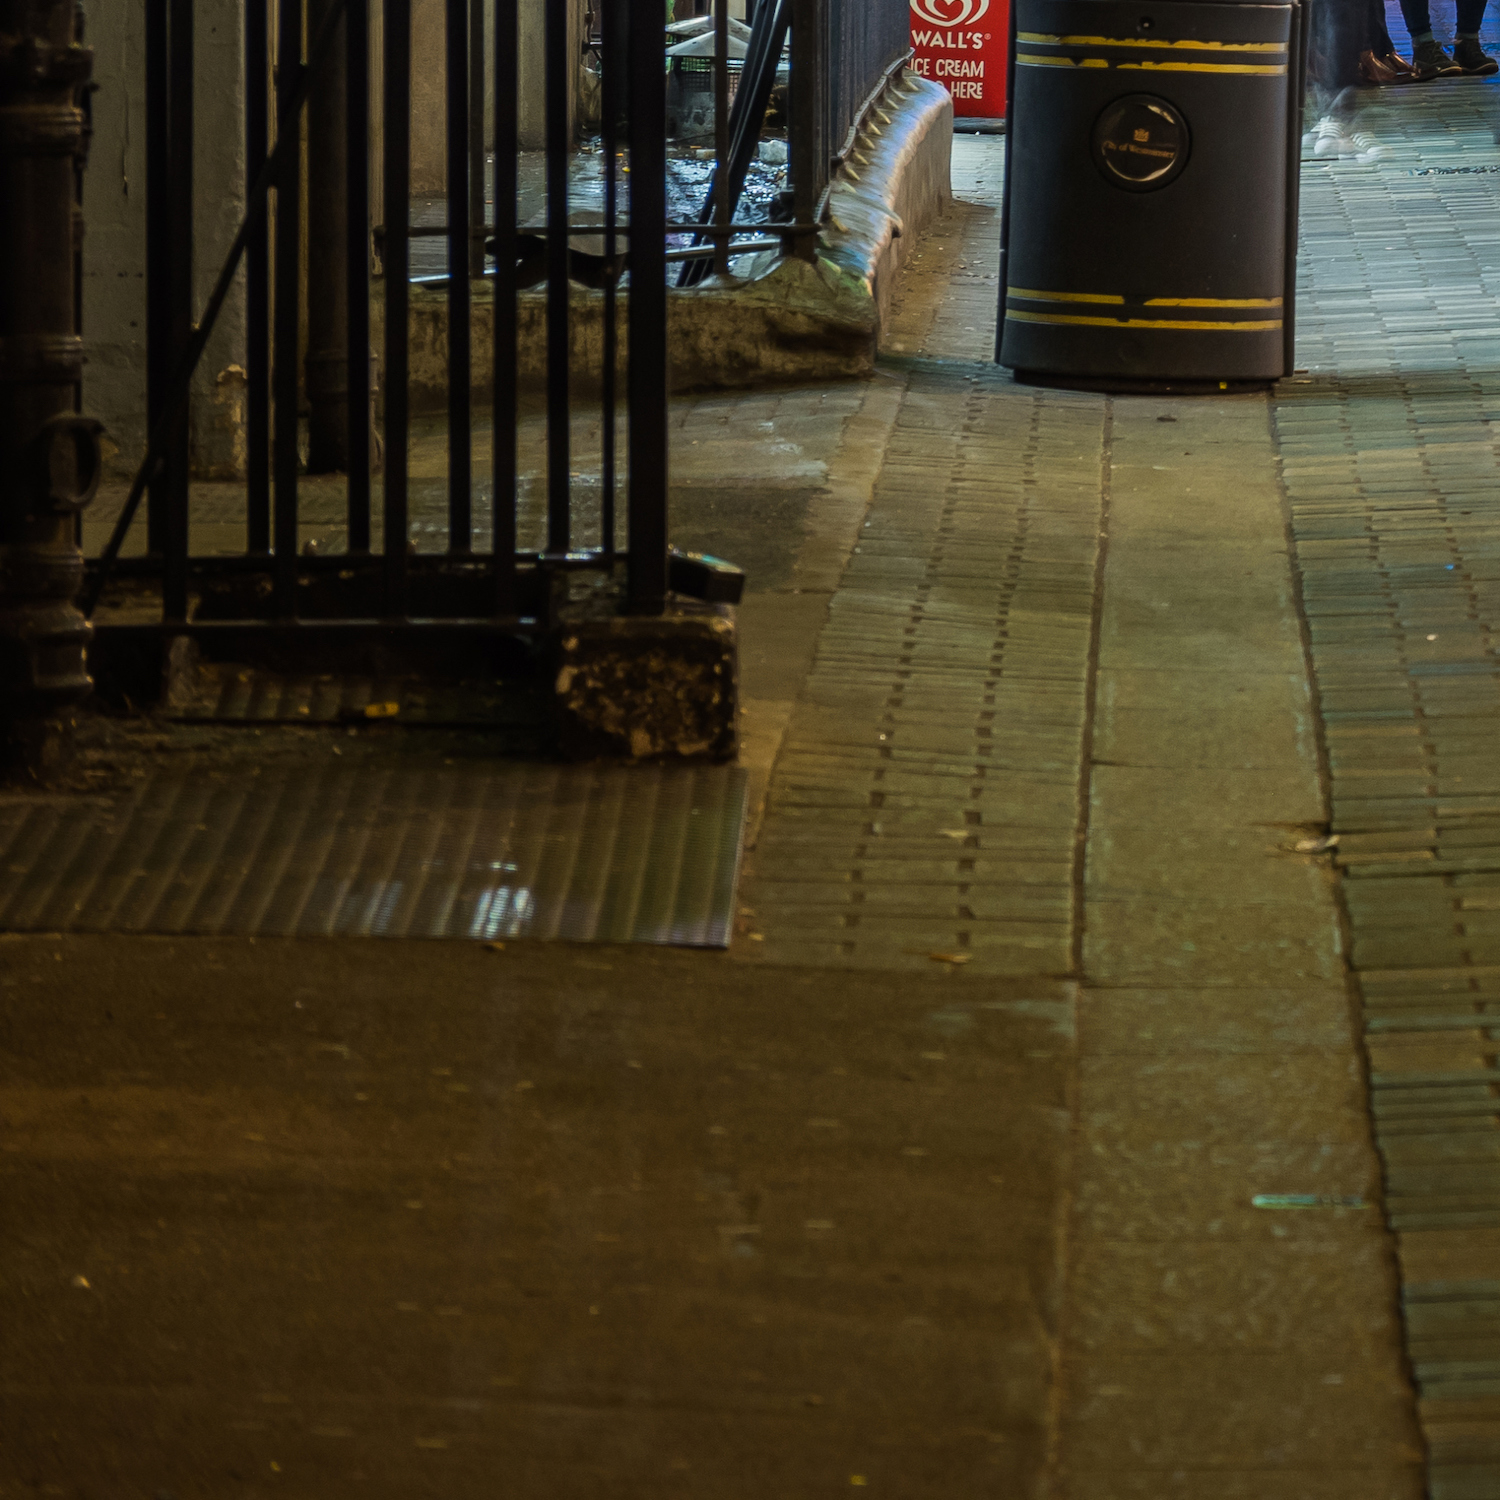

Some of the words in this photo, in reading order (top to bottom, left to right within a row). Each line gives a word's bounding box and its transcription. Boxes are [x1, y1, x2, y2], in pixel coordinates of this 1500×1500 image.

[911, 29, 983, 50] WALL'S
[911, 58, 931, 76] ICE
[935, 58, 985, 79] CREAM
[950, 81, 984, 100] HERE
